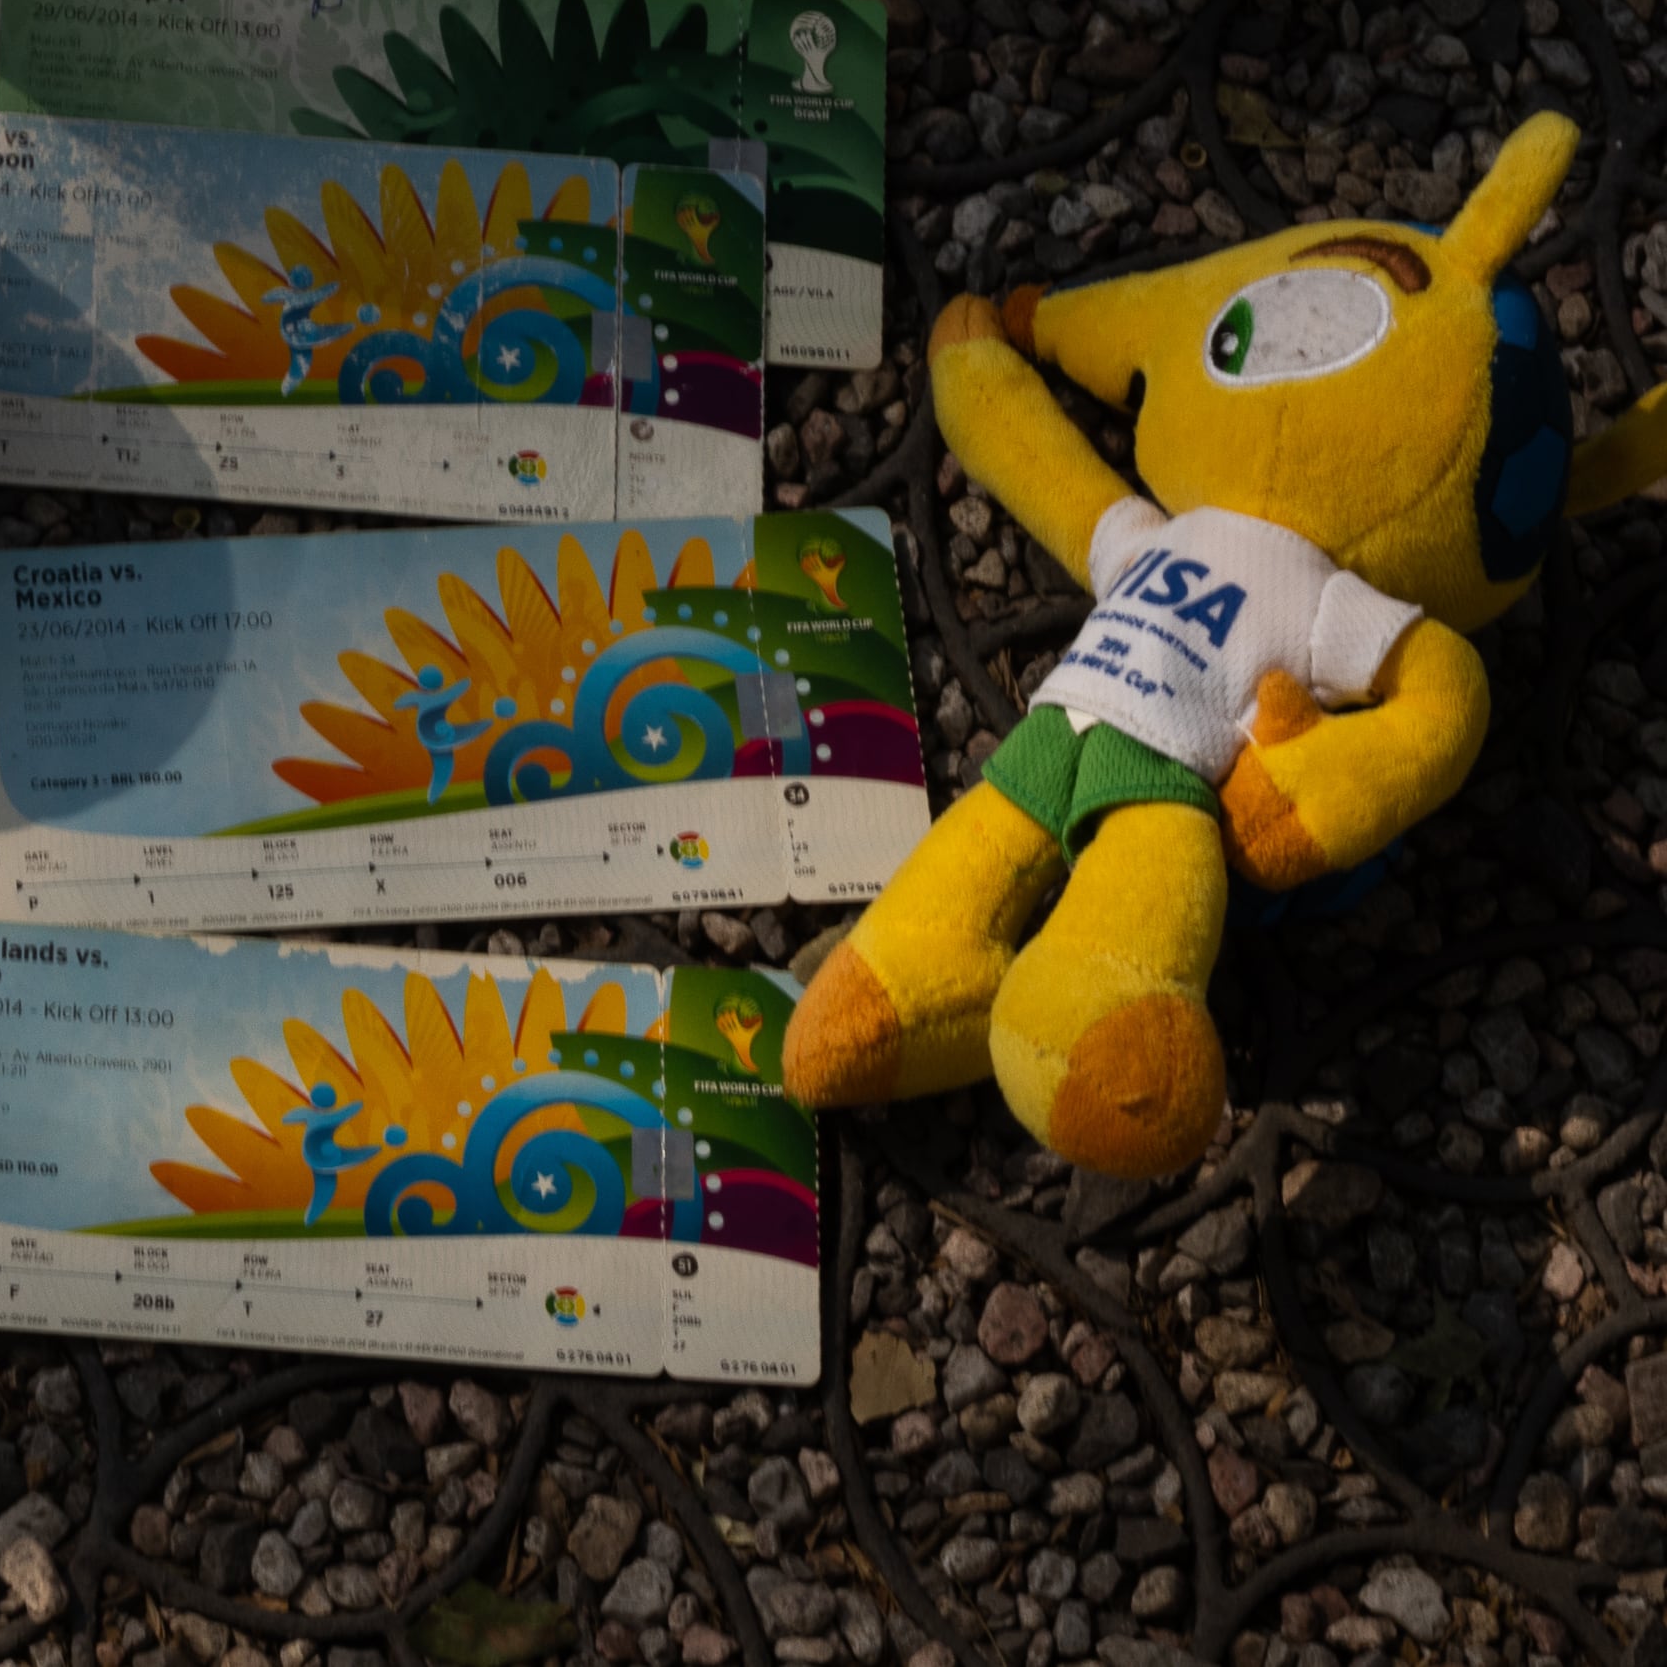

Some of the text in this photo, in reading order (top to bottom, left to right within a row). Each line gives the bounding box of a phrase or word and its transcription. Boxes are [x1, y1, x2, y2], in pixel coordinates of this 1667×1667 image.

[32, 2, 229, 37] 29/06/2014 Kick Off
[6, 127, 36, 148] vs.
[30, 183, 66, 201] Kick
[13, 562, 143, 586] Croatia vs.
[16, 585, 102, 611] Mexico
[18, 613, 218, 640] 23/06/2014 Kick Off
[1096, 635, 1130, 657] 2014
[1148, 624, 1209, 673] PARTNER
[30, 775, 88, 791] Category
[268, 872, 528, 902] 125 006
[76, 946, 109, 969] vs.
[43, 1002, 83, 1023] Kick
[89, 1004, 116, 1025] Off
[132, 1245, 169, 1259] BLOCK
